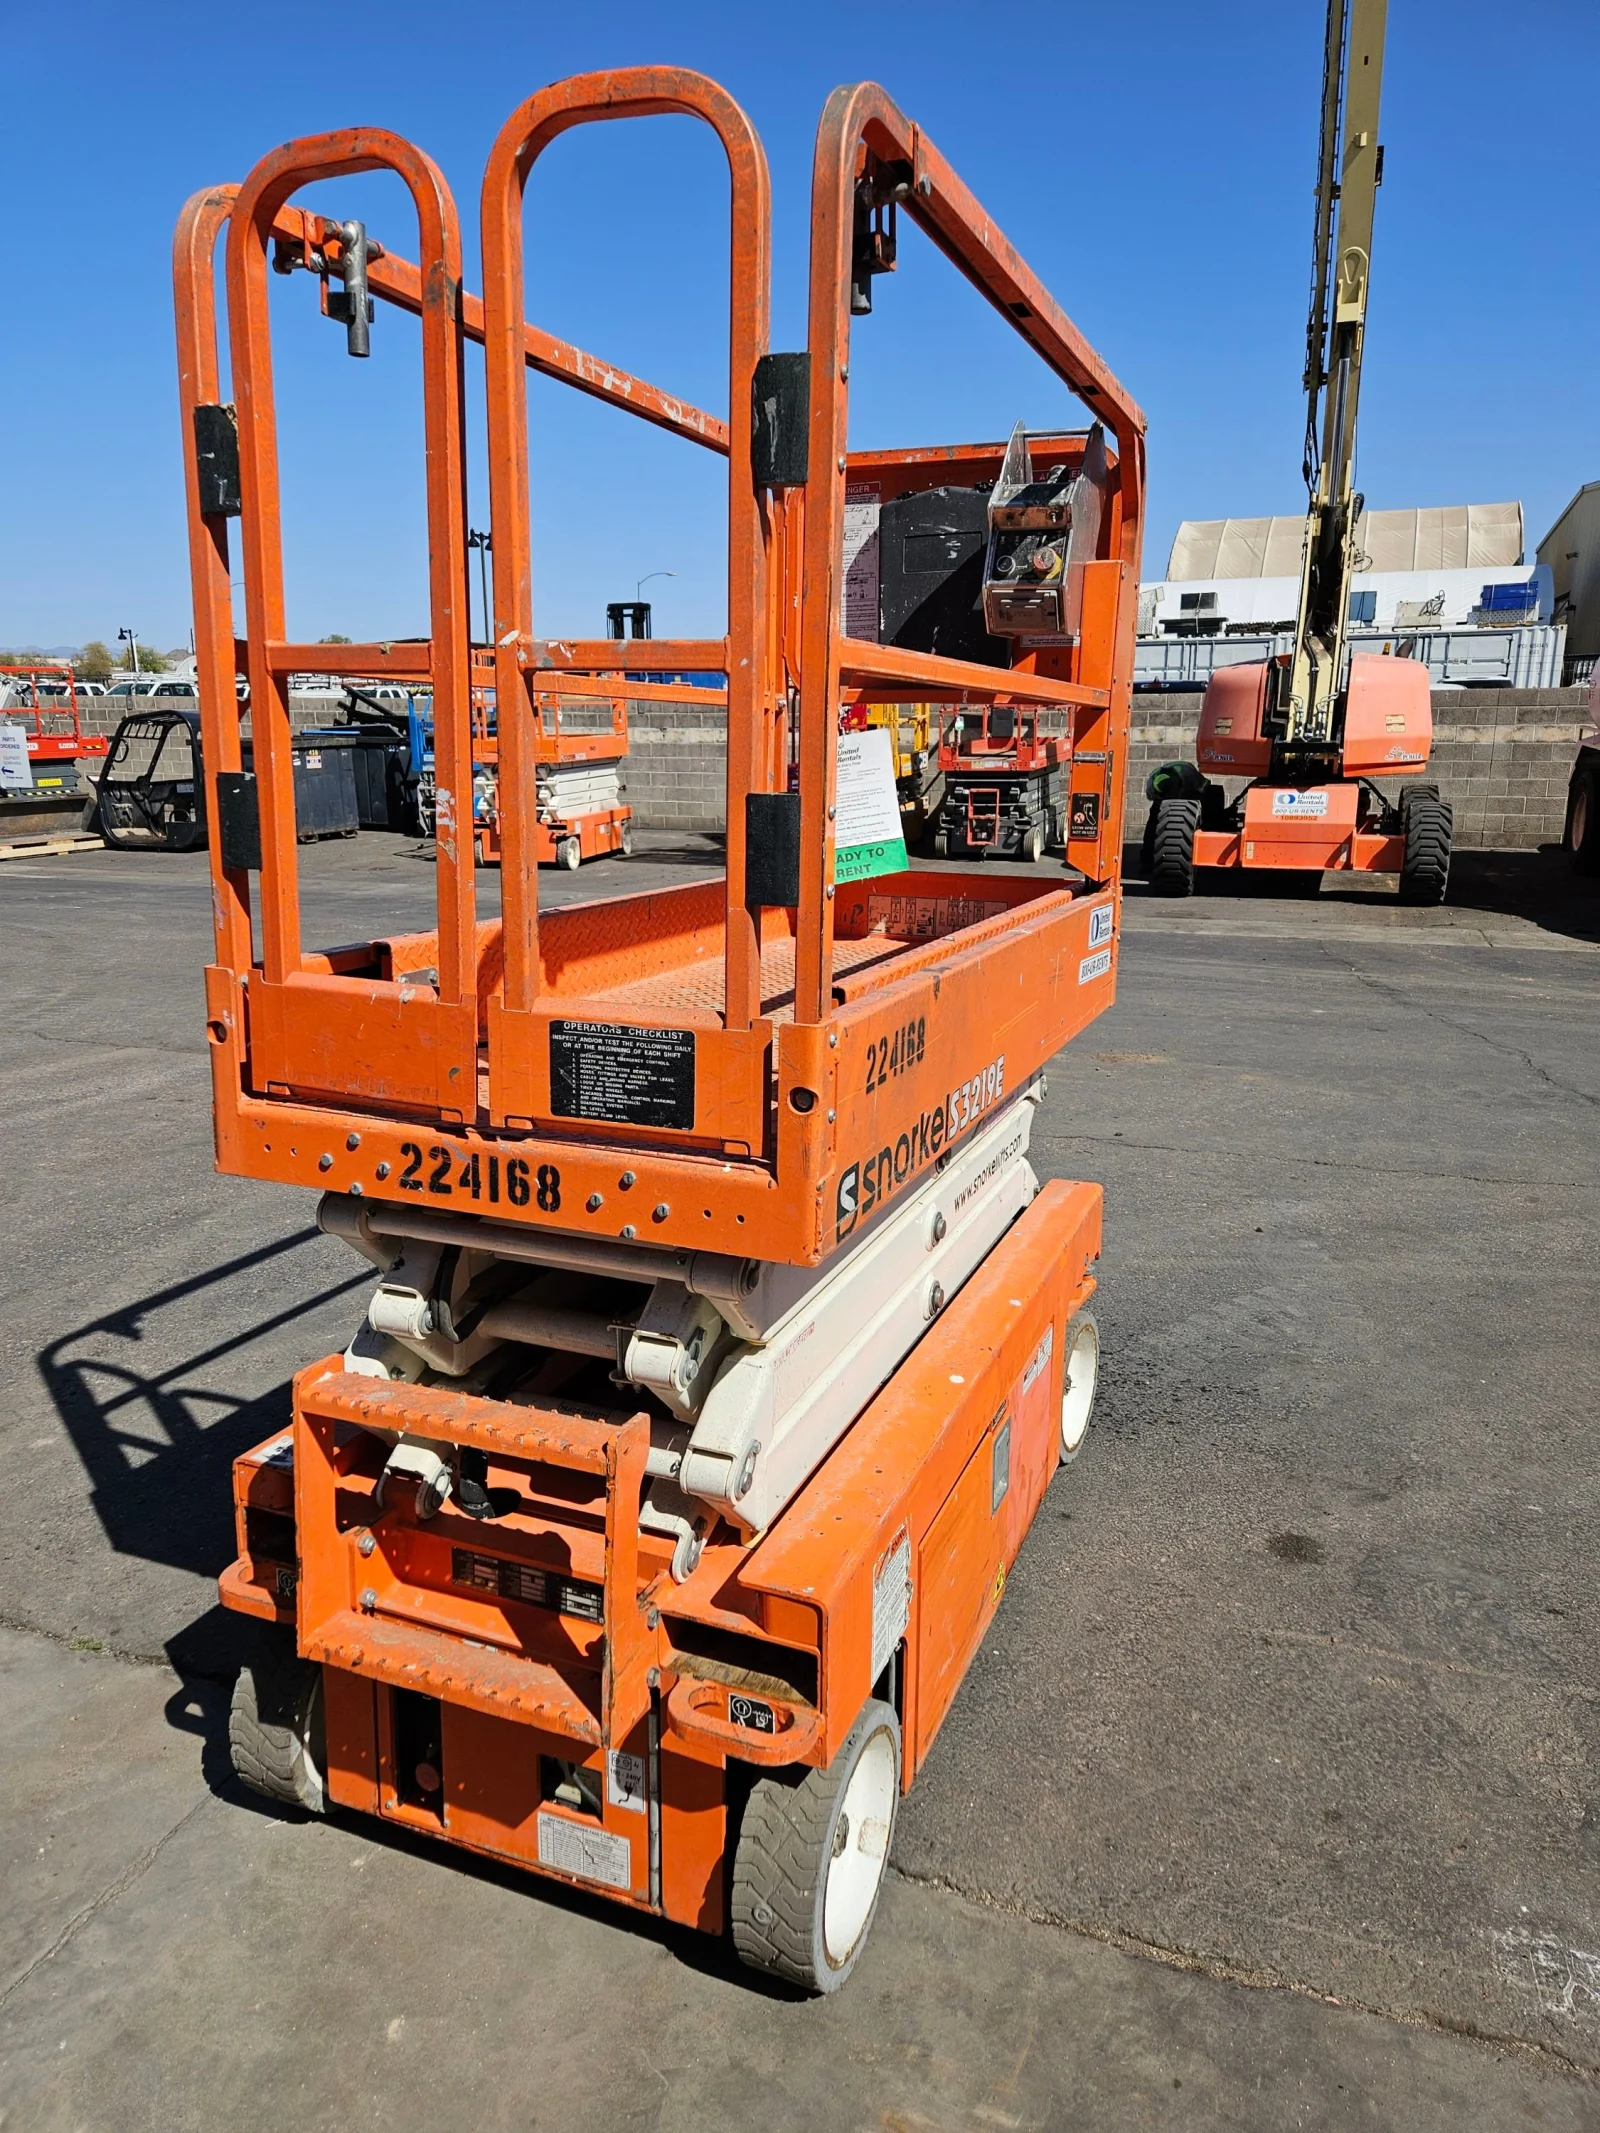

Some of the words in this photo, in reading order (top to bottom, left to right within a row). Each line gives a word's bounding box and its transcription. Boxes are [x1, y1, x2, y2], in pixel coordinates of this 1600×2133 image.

[845, 485, 870, 494] NGER
[837, 746, 859, 757] United
[837, 754, 861, 763] Rentals
[836, 851, 862, 864] ADY
[866, 847, 884, 858] TO
[836, 863, 871, 878] RENT
[1100, 911, 1111, 924] United
[563, 1021, 622, 1034] OPERATORS
[628, 1028, 684, 1040] CHECKLIST
[552, 1034, 577, 1042] INSPECT
[636, 1042, 672, 1050] FOLLOWING
[598, 1046, 630, 1054] BEGINNING
[866, 1017, 926, 1095] 224168
[861, 1094, 950, 1215] snorkel
[948, 1053, 1005, 1142] S3219E
[400, 1142, 562, 1213] 224168
